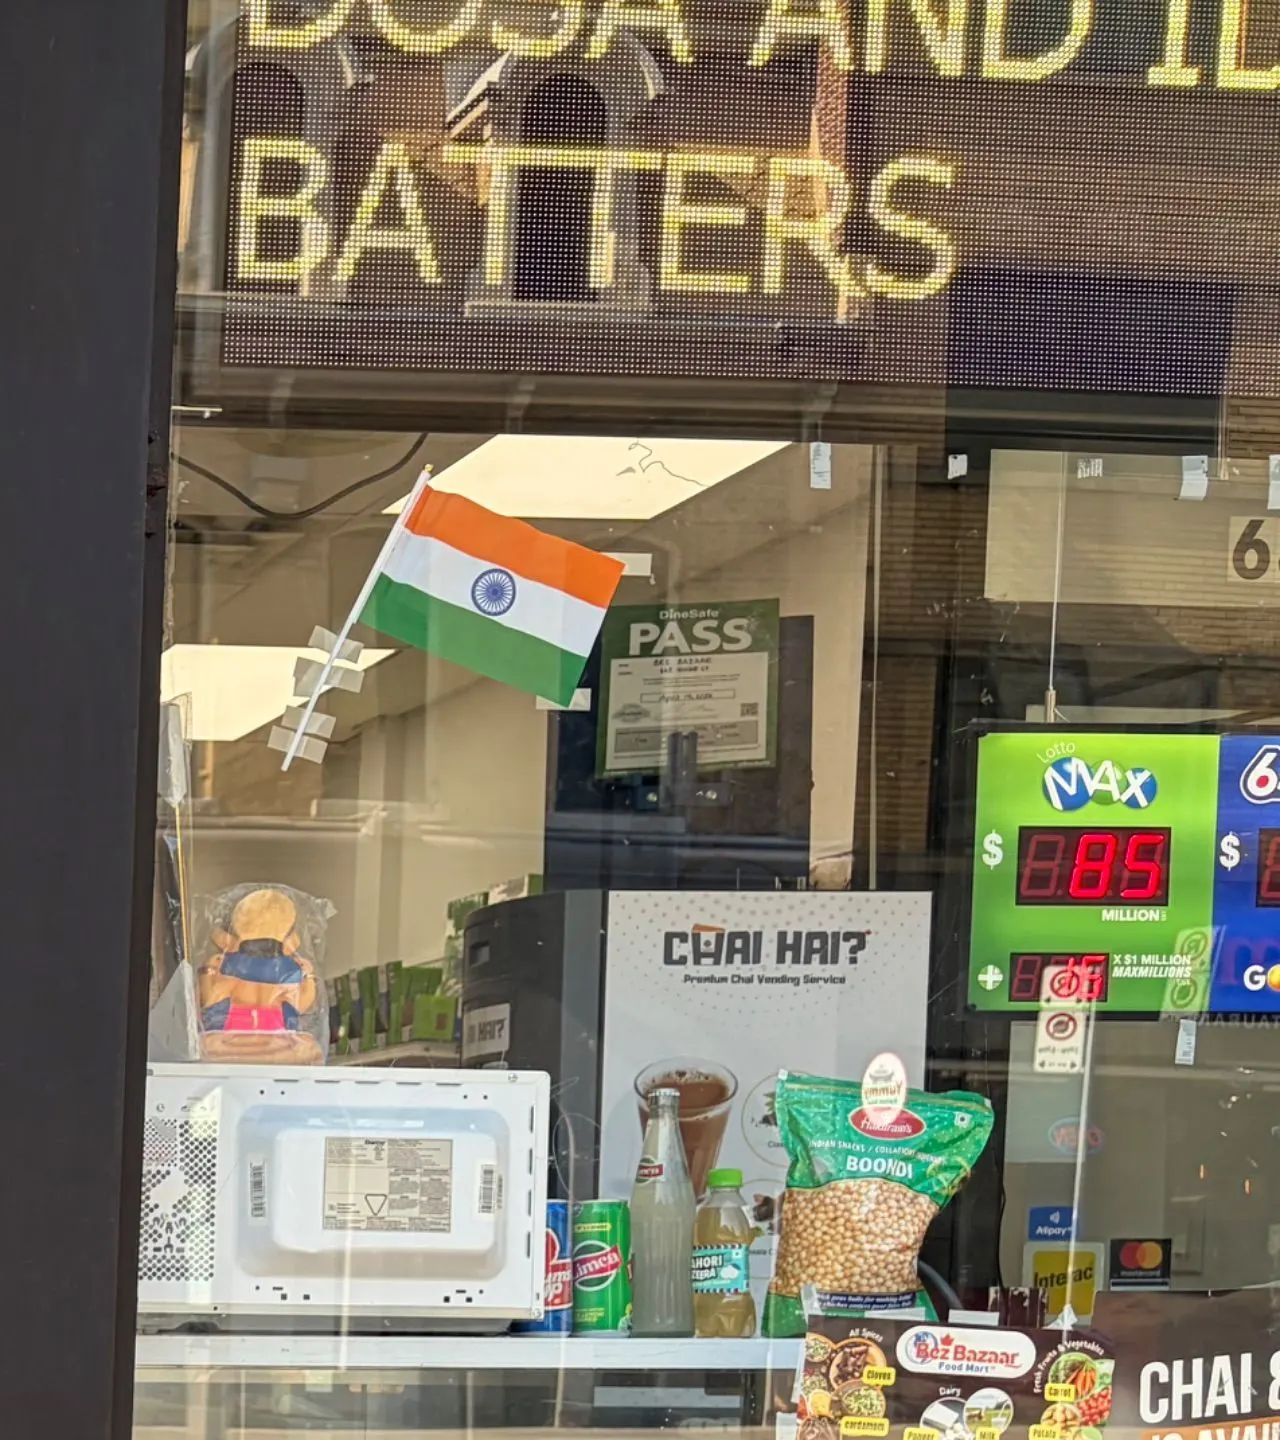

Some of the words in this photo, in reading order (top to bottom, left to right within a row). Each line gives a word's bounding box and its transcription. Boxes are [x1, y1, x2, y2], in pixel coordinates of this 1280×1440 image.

[237, 139, 958, 299] BATTERS
[659, 608, 720, 620] DineSafe
[629, 618, 753, 656] PASS
[1037, 741, 1076, 764] Lotto
[1043, 756, 1153, 811] MAX
[1219, 831, 1240, 871] $
[982, 829, 1004, 870] $
[1068, 833, 1166, 900] 85
[1101, 909, 1160, 922] MILLION
[663, 925, 763, 966] CHAI
[776, 929, 868, 966] HAI?
[1140, 954, 1191, 966] MILLION
[757, 974, 800, 987] Vending
[803, 974, 846, 985] Service
[1112, 966, 1192, 979] MAXMILLIONS
[846, 1155, 913, 1179] BOONDI
[691, 1255, 724, 1269] AHORI
[1033, 1267, 1094, 1289] Inteac
[916, 1343, 950, 1361] Bez
[953, 1344, 1021, 1365] Bazaar
[939, 1362, 963, 1371] Food
[966, 1364, 990, 1373] Mart
[939, 1386, 961, 1397] Dairy
[1140, 1352, 1253, 1425] CHAI
[979, 1431, 996, 1440] Milk
